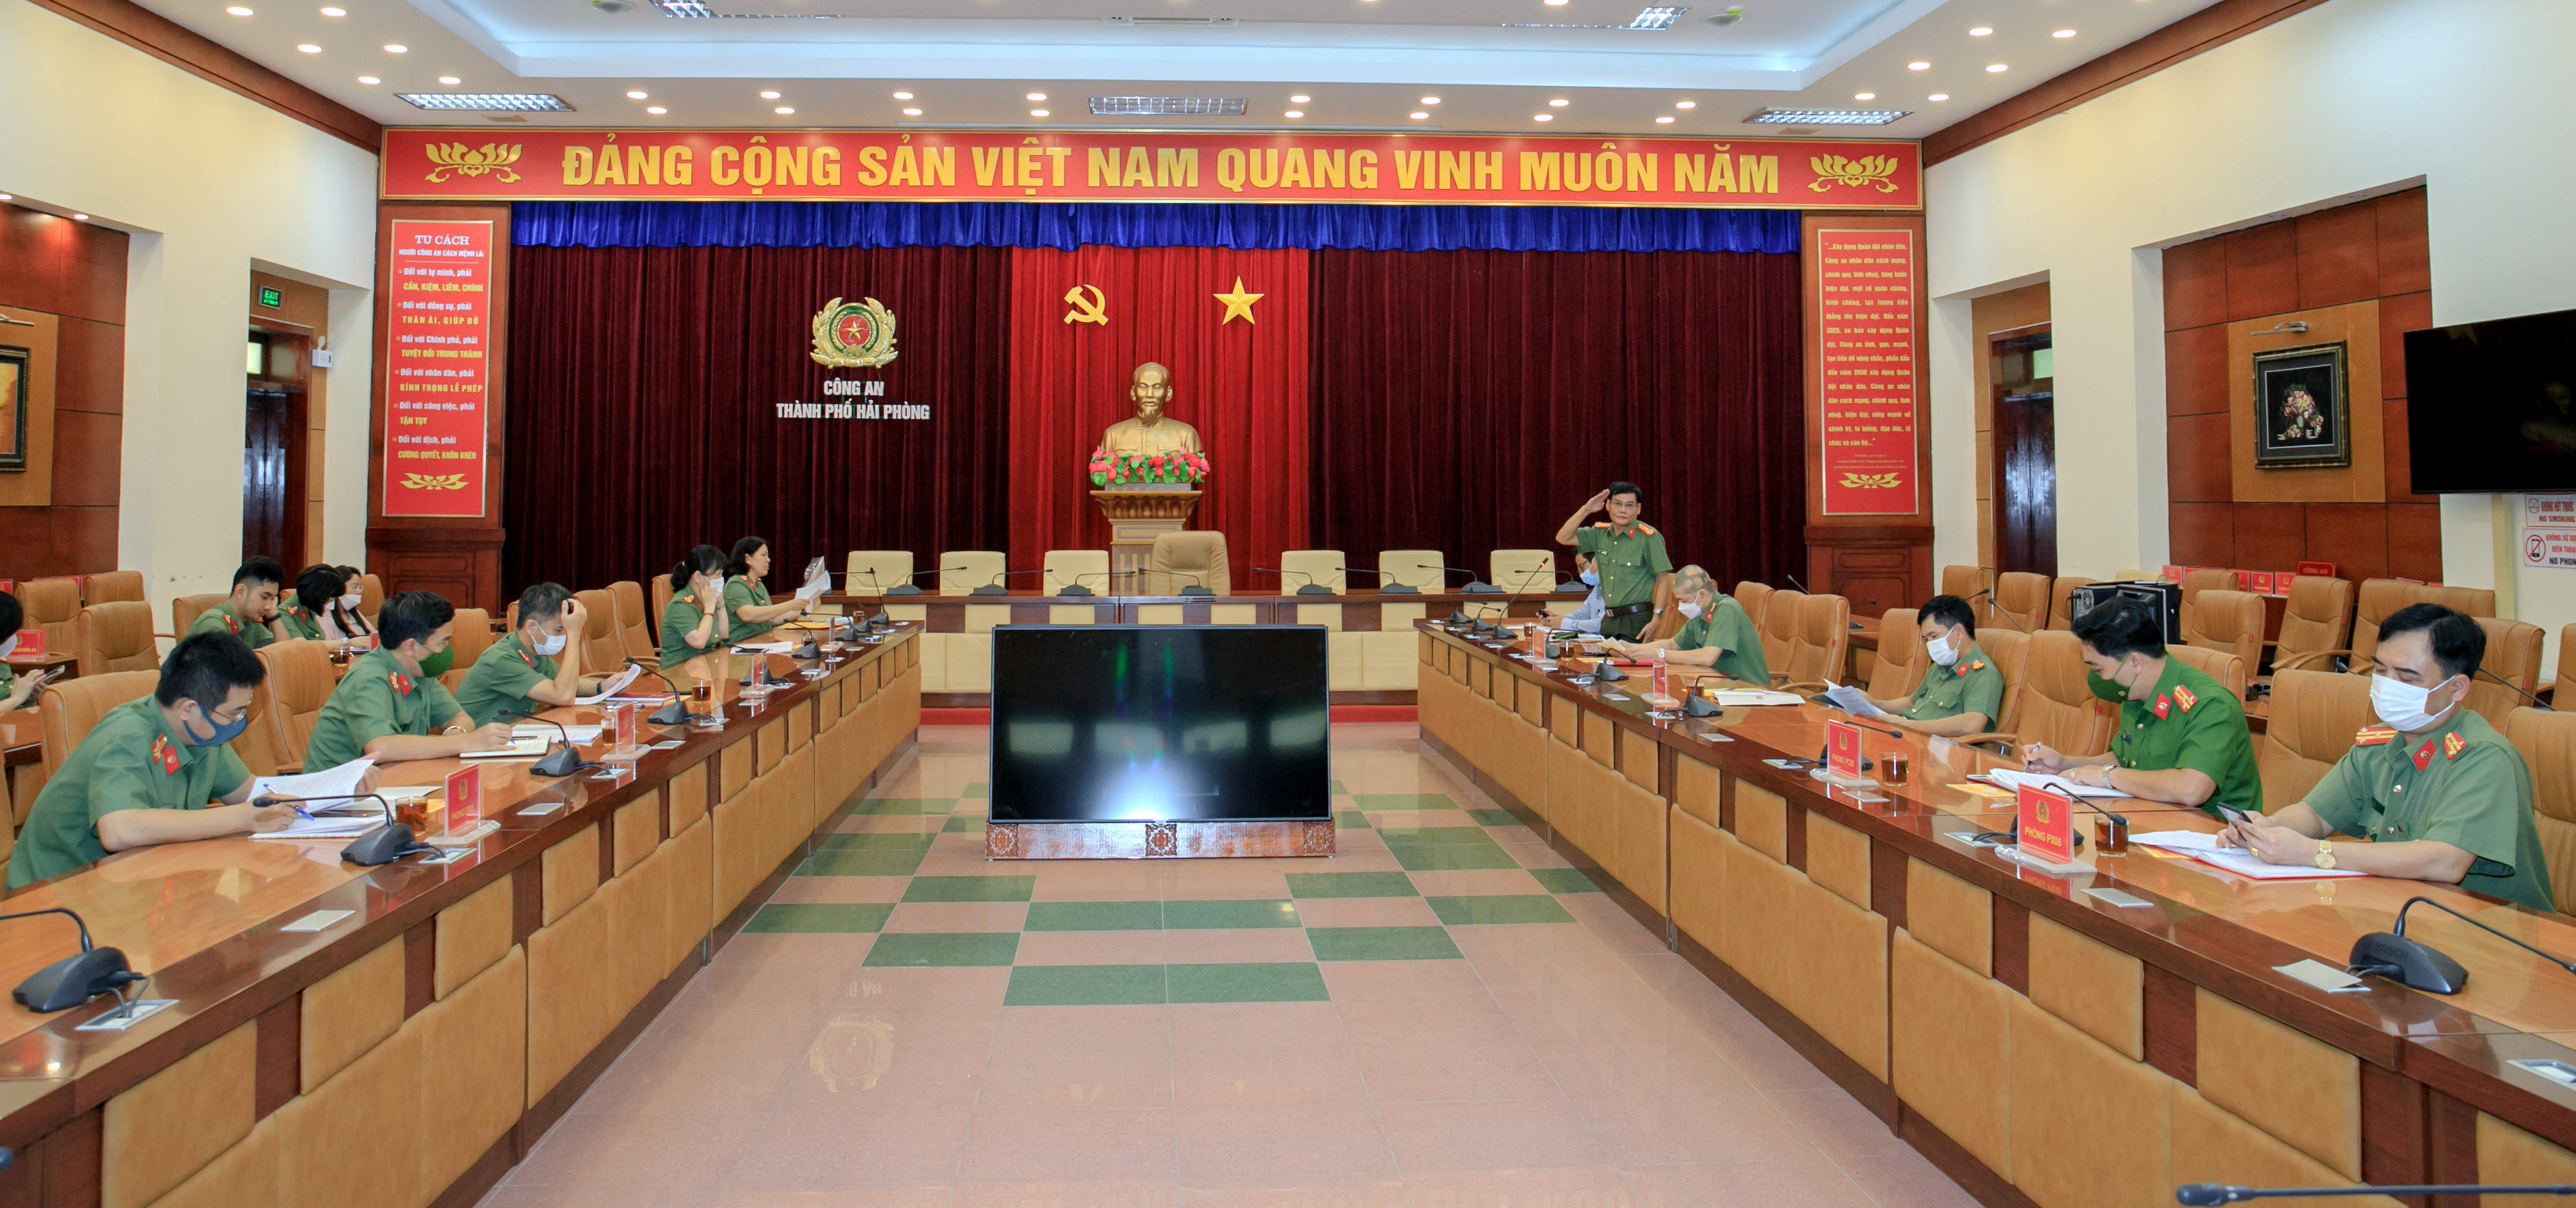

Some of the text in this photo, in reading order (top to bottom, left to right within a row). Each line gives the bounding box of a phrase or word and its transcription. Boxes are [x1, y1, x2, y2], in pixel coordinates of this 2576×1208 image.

[562, 132, 1778, 194] ĐẢNG CỘNG SẢN VIỆT NAM QUANG VINH MUÔN NĂM
[435, 234, 469, 245] CÁCH
[265, 290, 279, 300] EXIT
[403, 315, 425, 324] THÂN
[444, 316, 464, 324] GIÚP
[402, 334, 413, 343] Đối
[401, 368, 411, 376] Đối
[400, 382, 419, 391] KÍNH
[422, 384, 448, 393] TRỌNG
[462, 384, 482, 392] PHÉP
[824, 378, 884, 396] CÔNG AN
[400, 401, 411, 409] Đối
[777, 399, 929, 419] THÀNH PHỐ HẢI PHÒNG
[398, 435, 410, 443] Đối
[1832, 752, 1845, 764] PHÒNG
[2024, 826, 2062, 847] PHÒNG PX05
